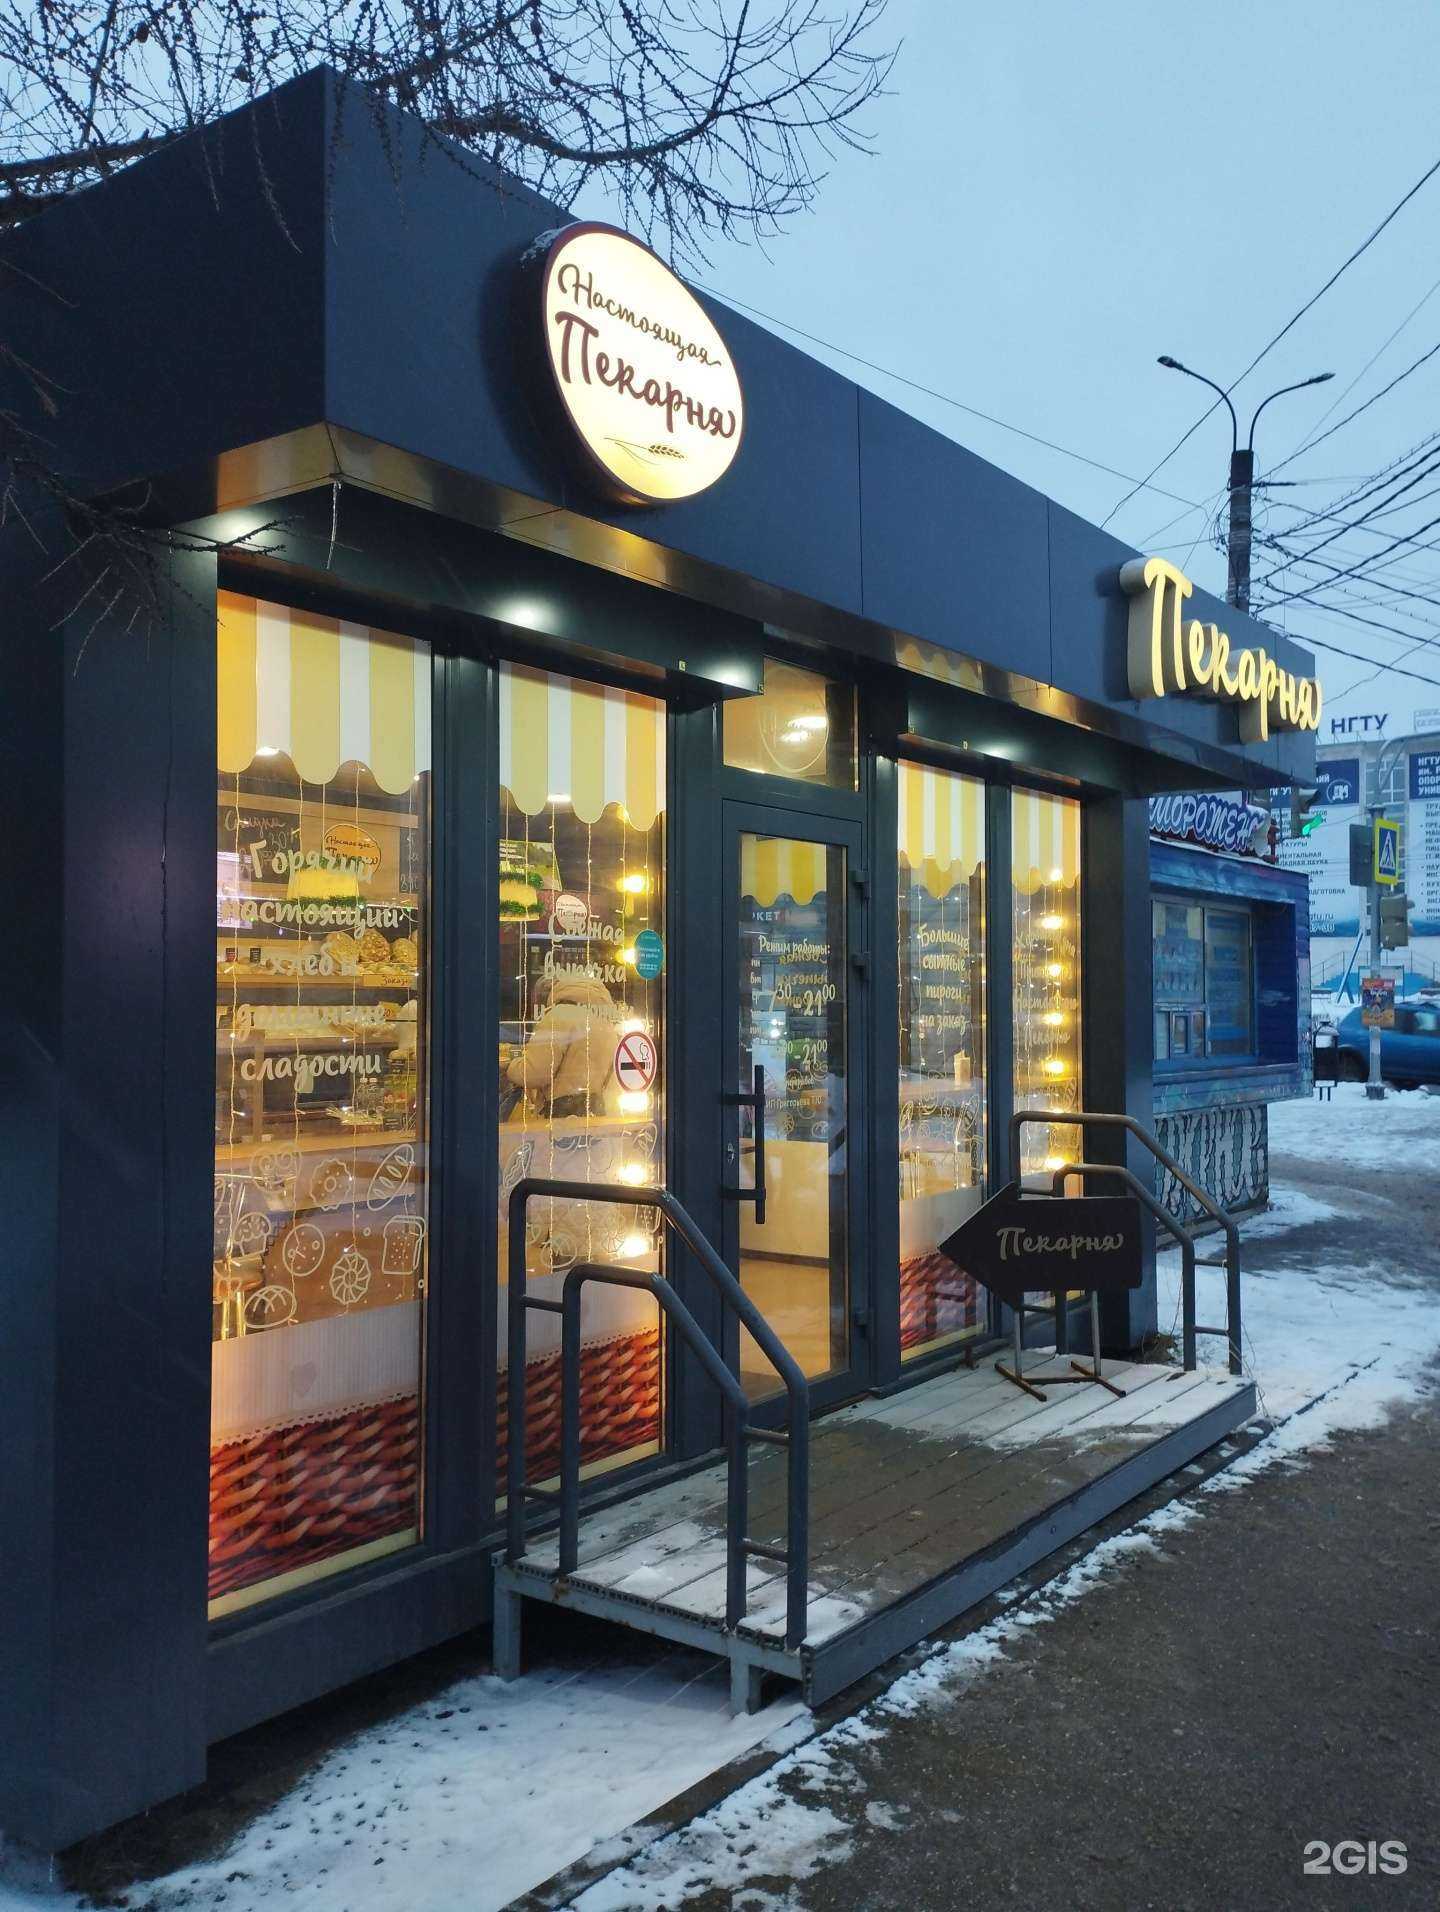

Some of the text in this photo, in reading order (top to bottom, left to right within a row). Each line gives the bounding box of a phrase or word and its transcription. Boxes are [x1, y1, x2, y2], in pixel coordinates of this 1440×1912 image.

[557, 263, 722, 367] Настоящая
[554, 311, 736, 438] Пекарня
[1143, 557, 1323, 742] Пекарня
[1331, 713, 1388, 734] НГТУ
[219, 898, 400, 940] настоящий
[918, 923, 970, 952] Большие
[758, 934, 791, 953] Режим
[926, 985, 962, 1007] пироги
[240, 1053, 382, 1091] сладости
[996, 1225, 1124, 1261] Пекарня
